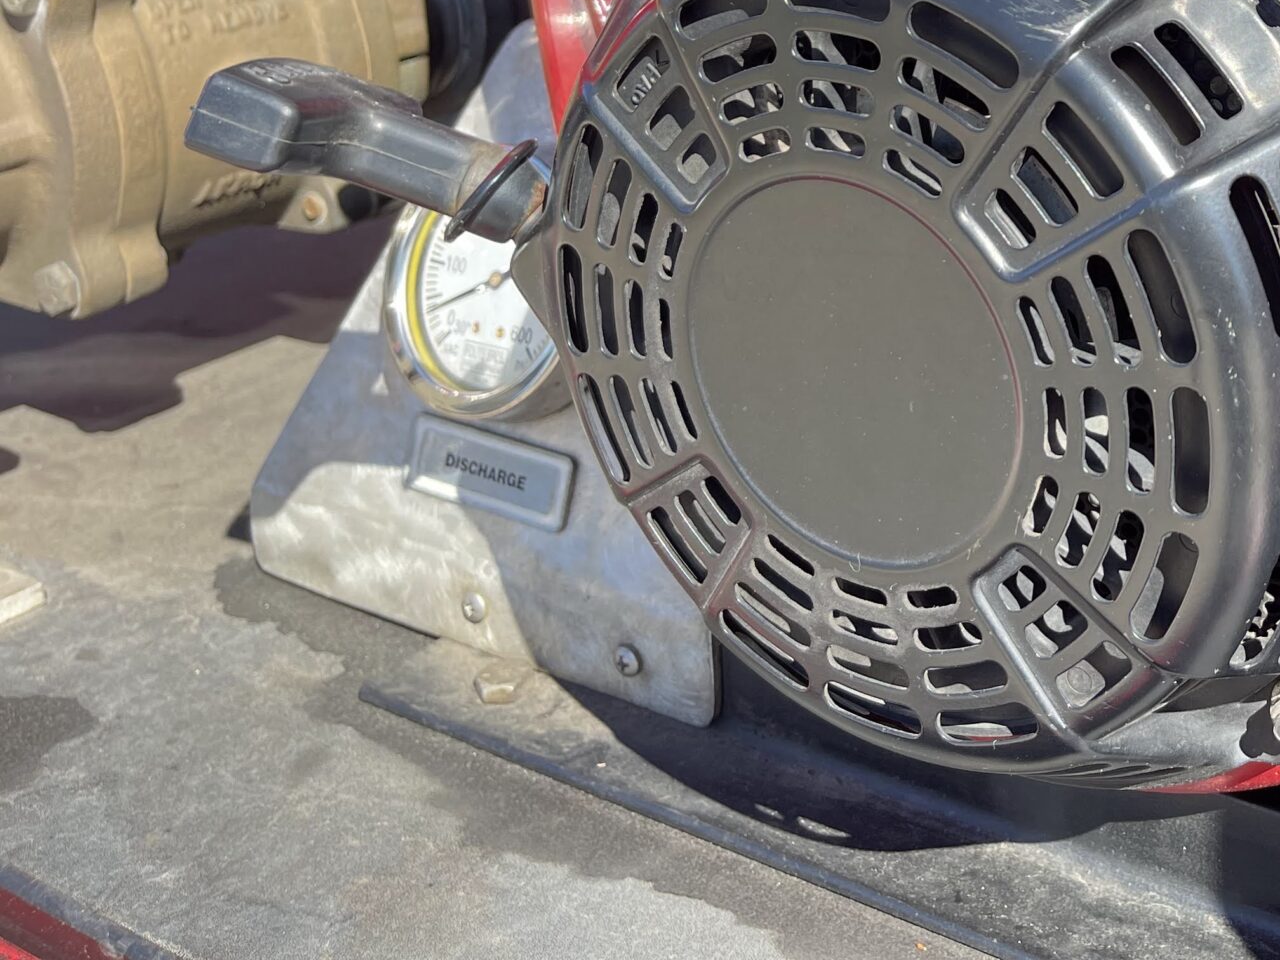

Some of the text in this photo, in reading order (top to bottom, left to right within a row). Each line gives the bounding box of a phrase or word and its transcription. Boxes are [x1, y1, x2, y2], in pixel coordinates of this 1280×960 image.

[446, 255, 467, 275] 100
[510, 325, 533, 345] 600
[445, 453, 528, 491] DISCHARGE
